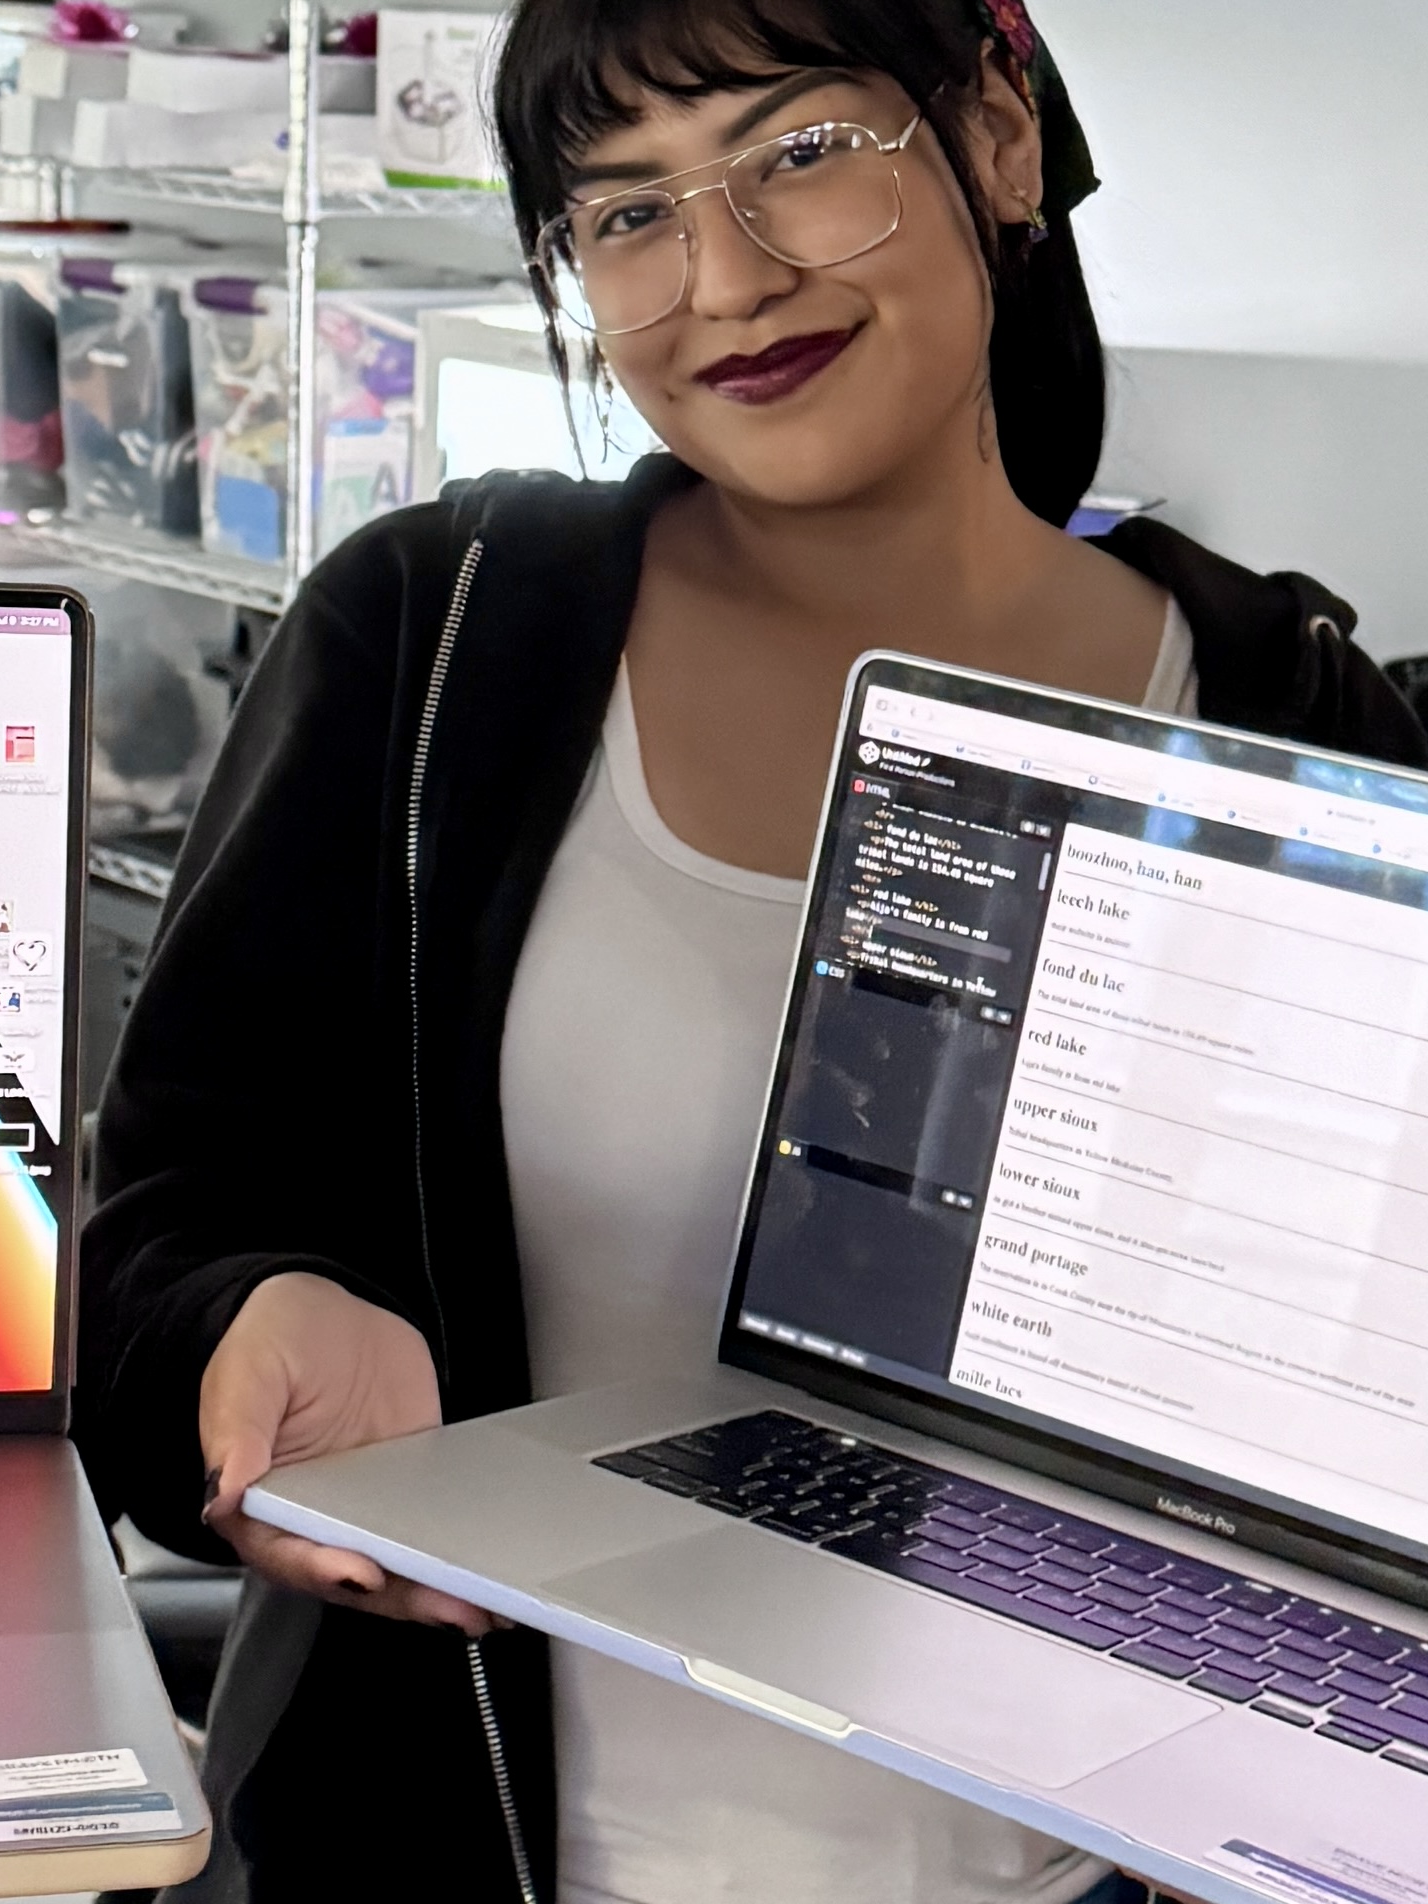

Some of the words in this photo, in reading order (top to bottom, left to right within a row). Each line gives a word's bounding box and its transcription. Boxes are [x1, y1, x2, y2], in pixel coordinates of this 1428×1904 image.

[1067, 843, 1133, 876] boozhoo,
[1136, 860, 1170, 884] hau,
[1173, 869, 1203, 891] han
[1057, 888, 1094, 912] leech
[1097, 898, 1130, 921] lake
[1042, 958, 1076, 980] fond
[1079, 968, 1099, 987] du
[1102, 973, 1125, 993] lac
[1028, 1029, 1053, 1047] red
[1055, 1033, 1087, 1056] lake
[1013, 1098, 1058, 1120] upper
[1059, 1109, 1098, 1133] sioux
[999, 1162, 1040, 1188] lower
[1042, 1176, 1080, 1201] sioux
[984, 1235, 1029, 1257] grand
[1030, 1248, 1089, 1277] portage
[971, 1300, 1010, 1324] white
[1012, 1315, 1052, 1338] earth
[956, 1369, 992, 1388] mille
[995, 1376, 1022, 1399] lacs
[1155, 1496, 1213, 1528] MacBook
[1214, 1515, 1236, 1536] Pro
